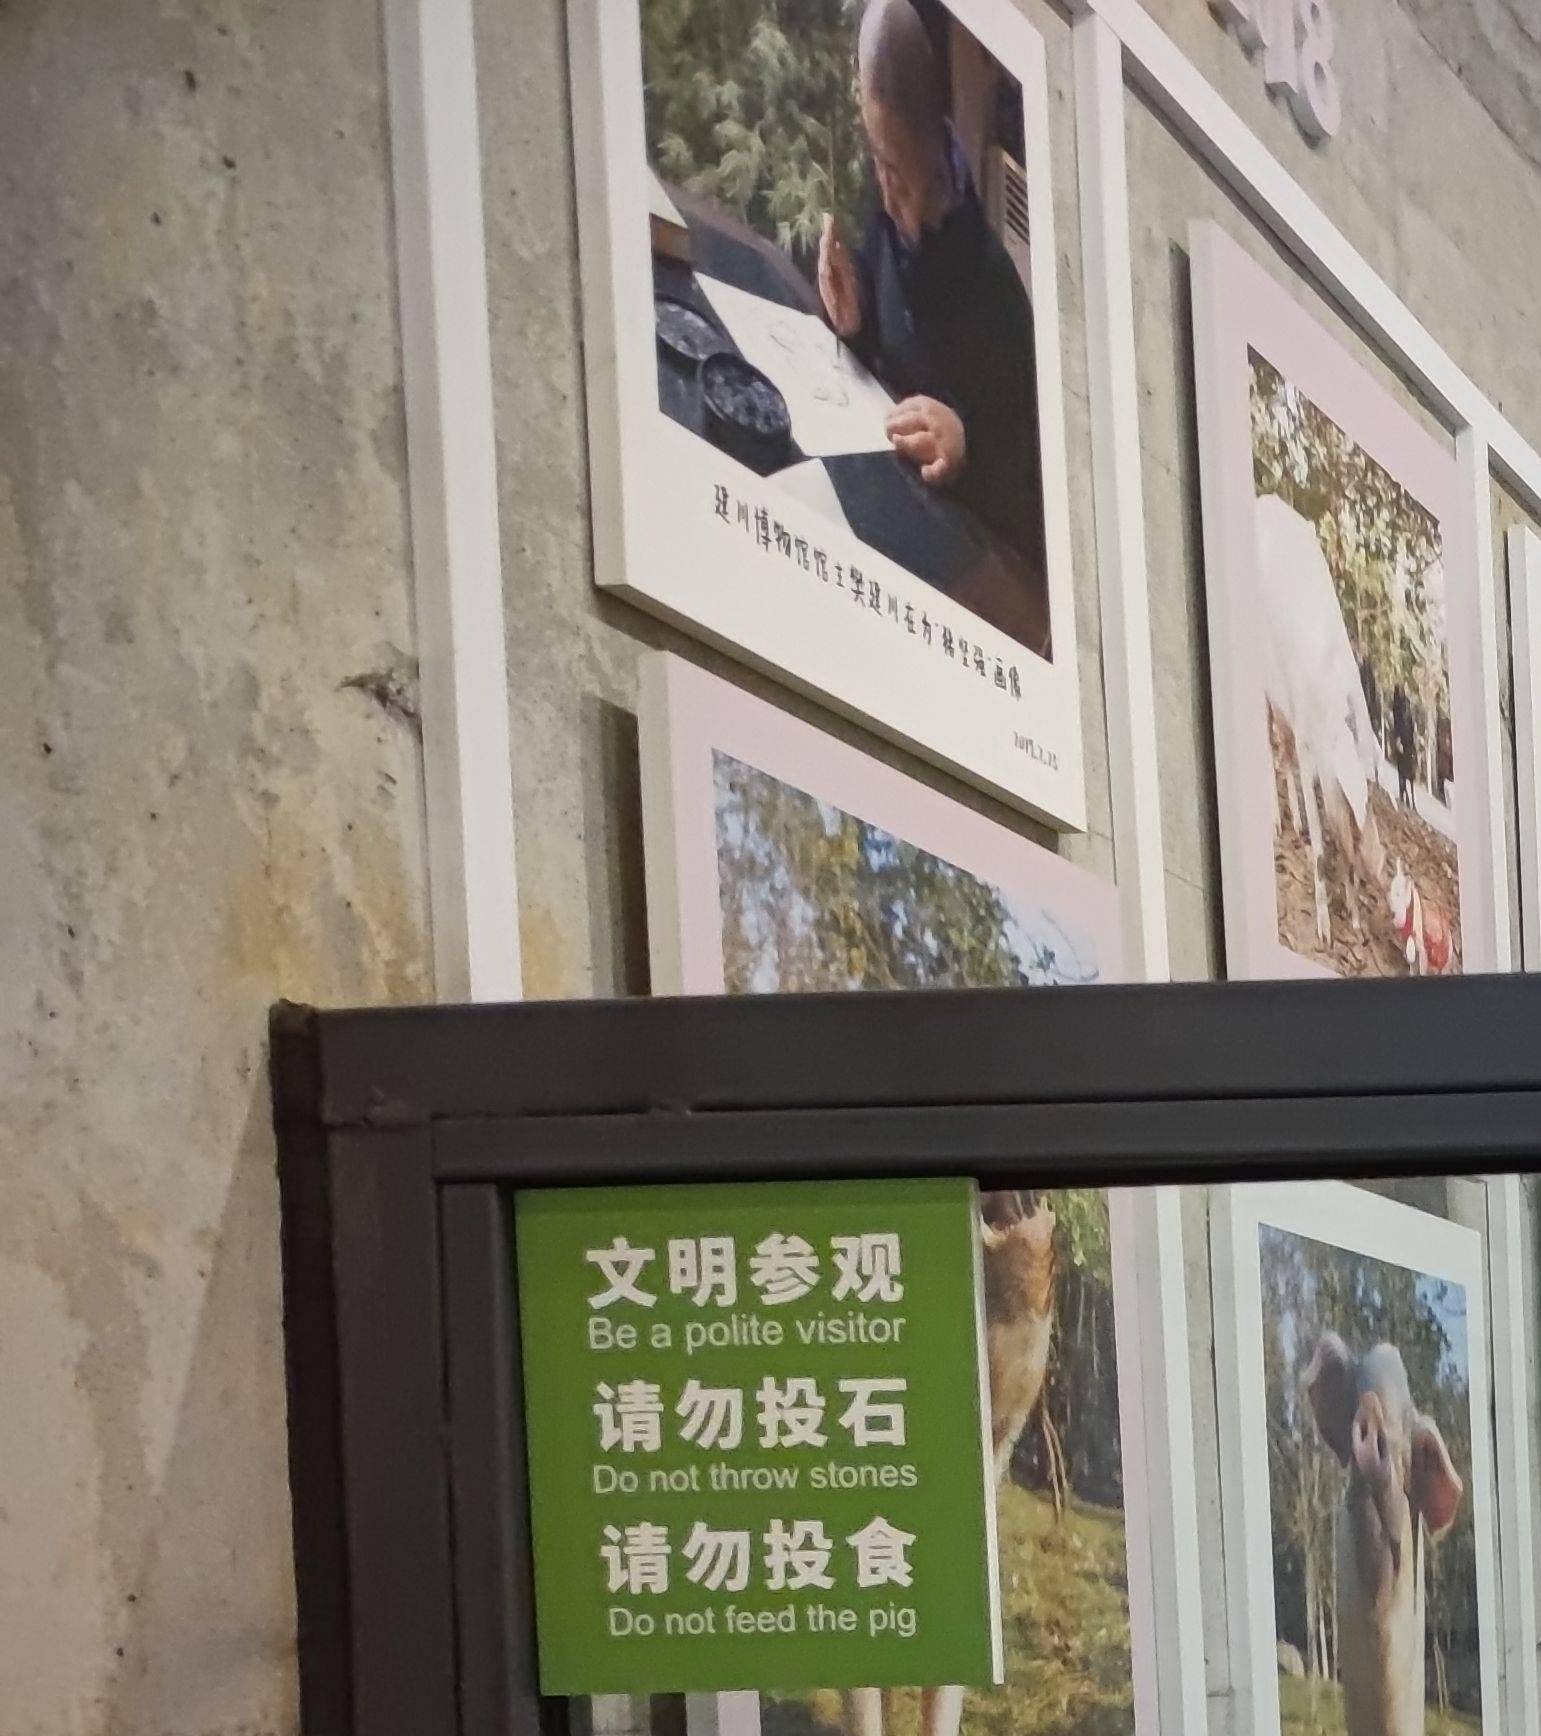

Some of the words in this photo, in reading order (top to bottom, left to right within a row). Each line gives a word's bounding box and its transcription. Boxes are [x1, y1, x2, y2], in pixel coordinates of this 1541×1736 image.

[585, 1232, 904, 1310] 文明参观
[588, 1317, 638, 1350] Be
[650, 1325, 672, 1348] a
[685, 1313, 783, 1355] polite
[796, 1312, 906, 1346] visitor
[592, 1376, 908, 1453] 请勿投石
[592, 1464, 638, 1494] Do
[649, 1463, 699, 1492] not
[710, 1462, 799, 1490] throw
[810, 1462, 918, 1488] stones
[601, 1515, 917, 1595] 请勿投食
[609, 1607, 655, 1637] Do
[665, 1606, 715, 1635] not
[726, 1603, 796, 1633] feed
[806, 1601, 857, 1631] the
[869, 1601, 917, 1637] pig
